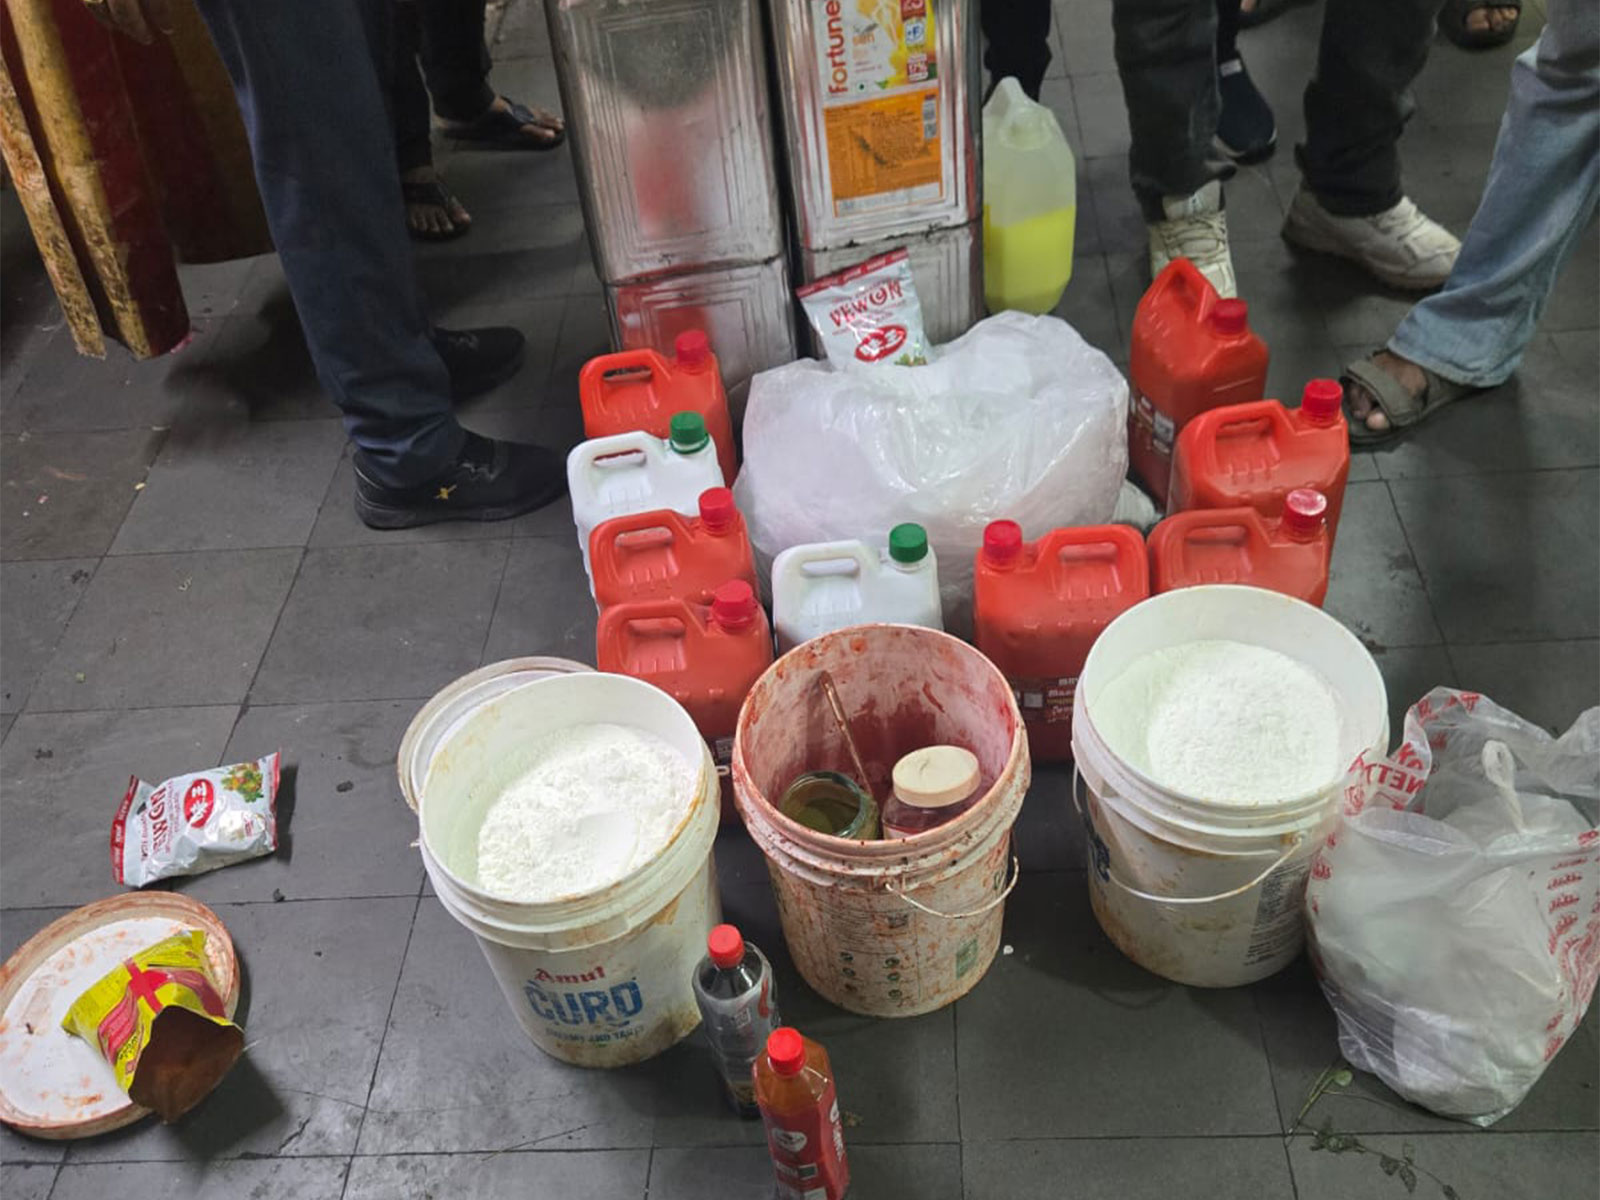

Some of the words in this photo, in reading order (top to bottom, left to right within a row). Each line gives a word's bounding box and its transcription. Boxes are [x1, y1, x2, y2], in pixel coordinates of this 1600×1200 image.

[825, 0, 848, 93] fortune
[534, 966, 606, 984] Amul
[524, 980, 643, 1026] CURD
